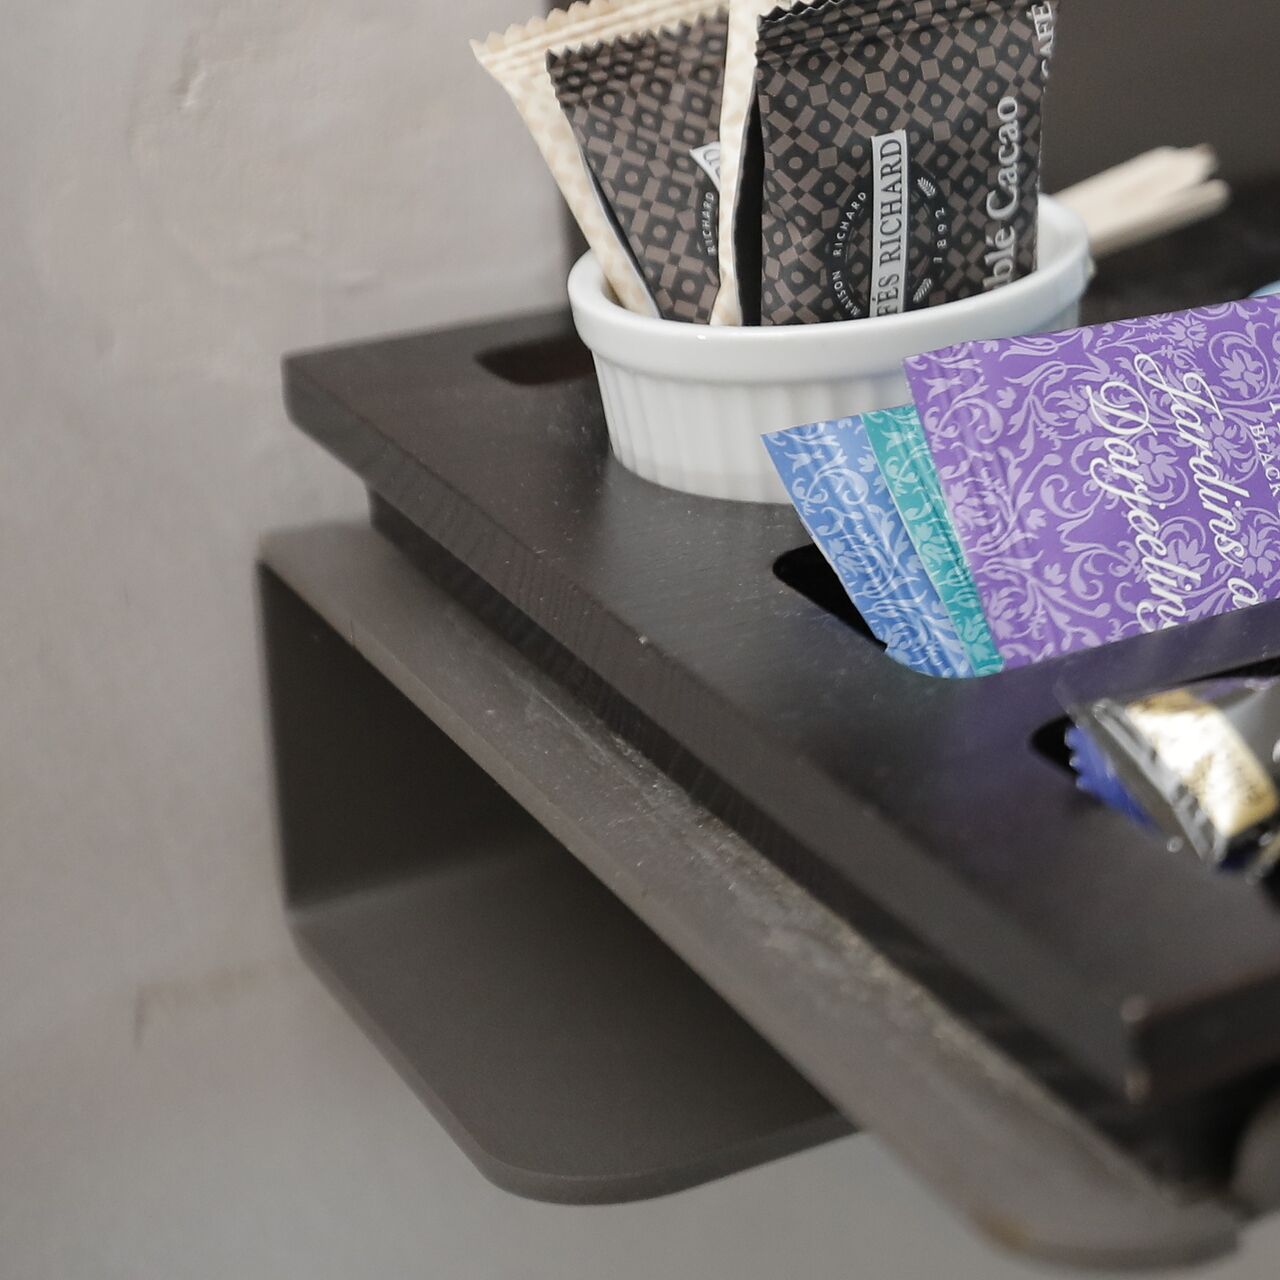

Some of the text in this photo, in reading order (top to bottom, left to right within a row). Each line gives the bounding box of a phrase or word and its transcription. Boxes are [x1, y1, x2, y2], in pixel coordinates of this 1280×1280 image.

[706, 191, 716, 256] RICHARD
[832, 191, 867, 316] MAISON RICHARD
[878, 138, 903, 268] RICHARD
[932, 207, 948, 264] 1892
[983, 96, 1020, 289] blé Cacao
[1134, 353, 1251, 568] Jardins
